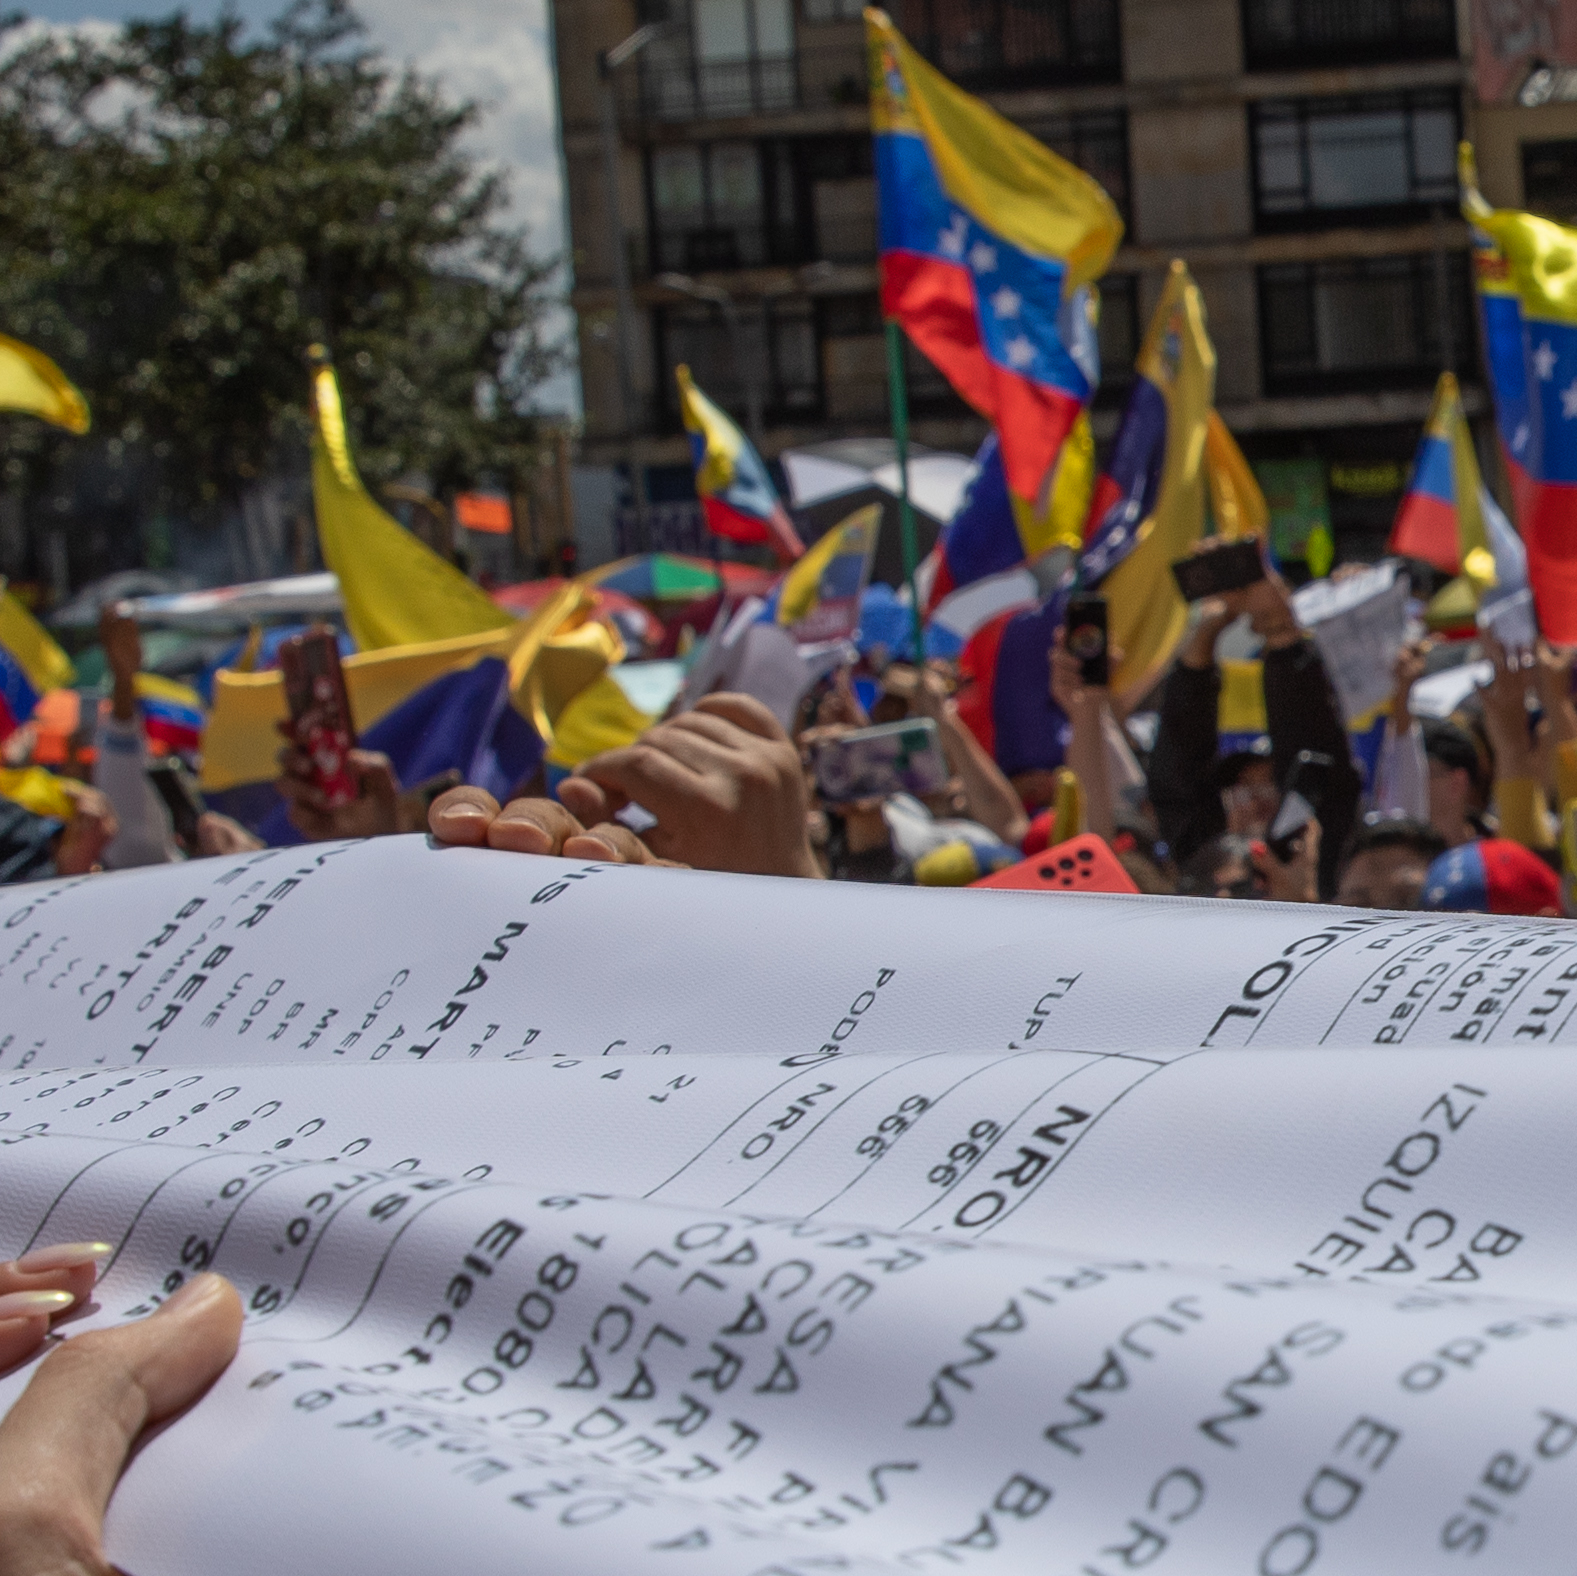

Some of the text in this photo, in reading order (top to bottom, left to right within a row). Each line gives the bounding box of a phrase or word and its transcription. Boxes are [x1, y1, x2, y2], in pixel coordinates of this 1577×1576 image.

[85, 897, 209, 1021] BRITO
[332, 968, 411, 1055] COPEI
[1008, 971, 1084, 1051] TUP
[927, 1118, 1002, 1188] 556
[931, 1104, 1092, 1232] NRO.
[1197, 1320, 1347, 1450] SAN
